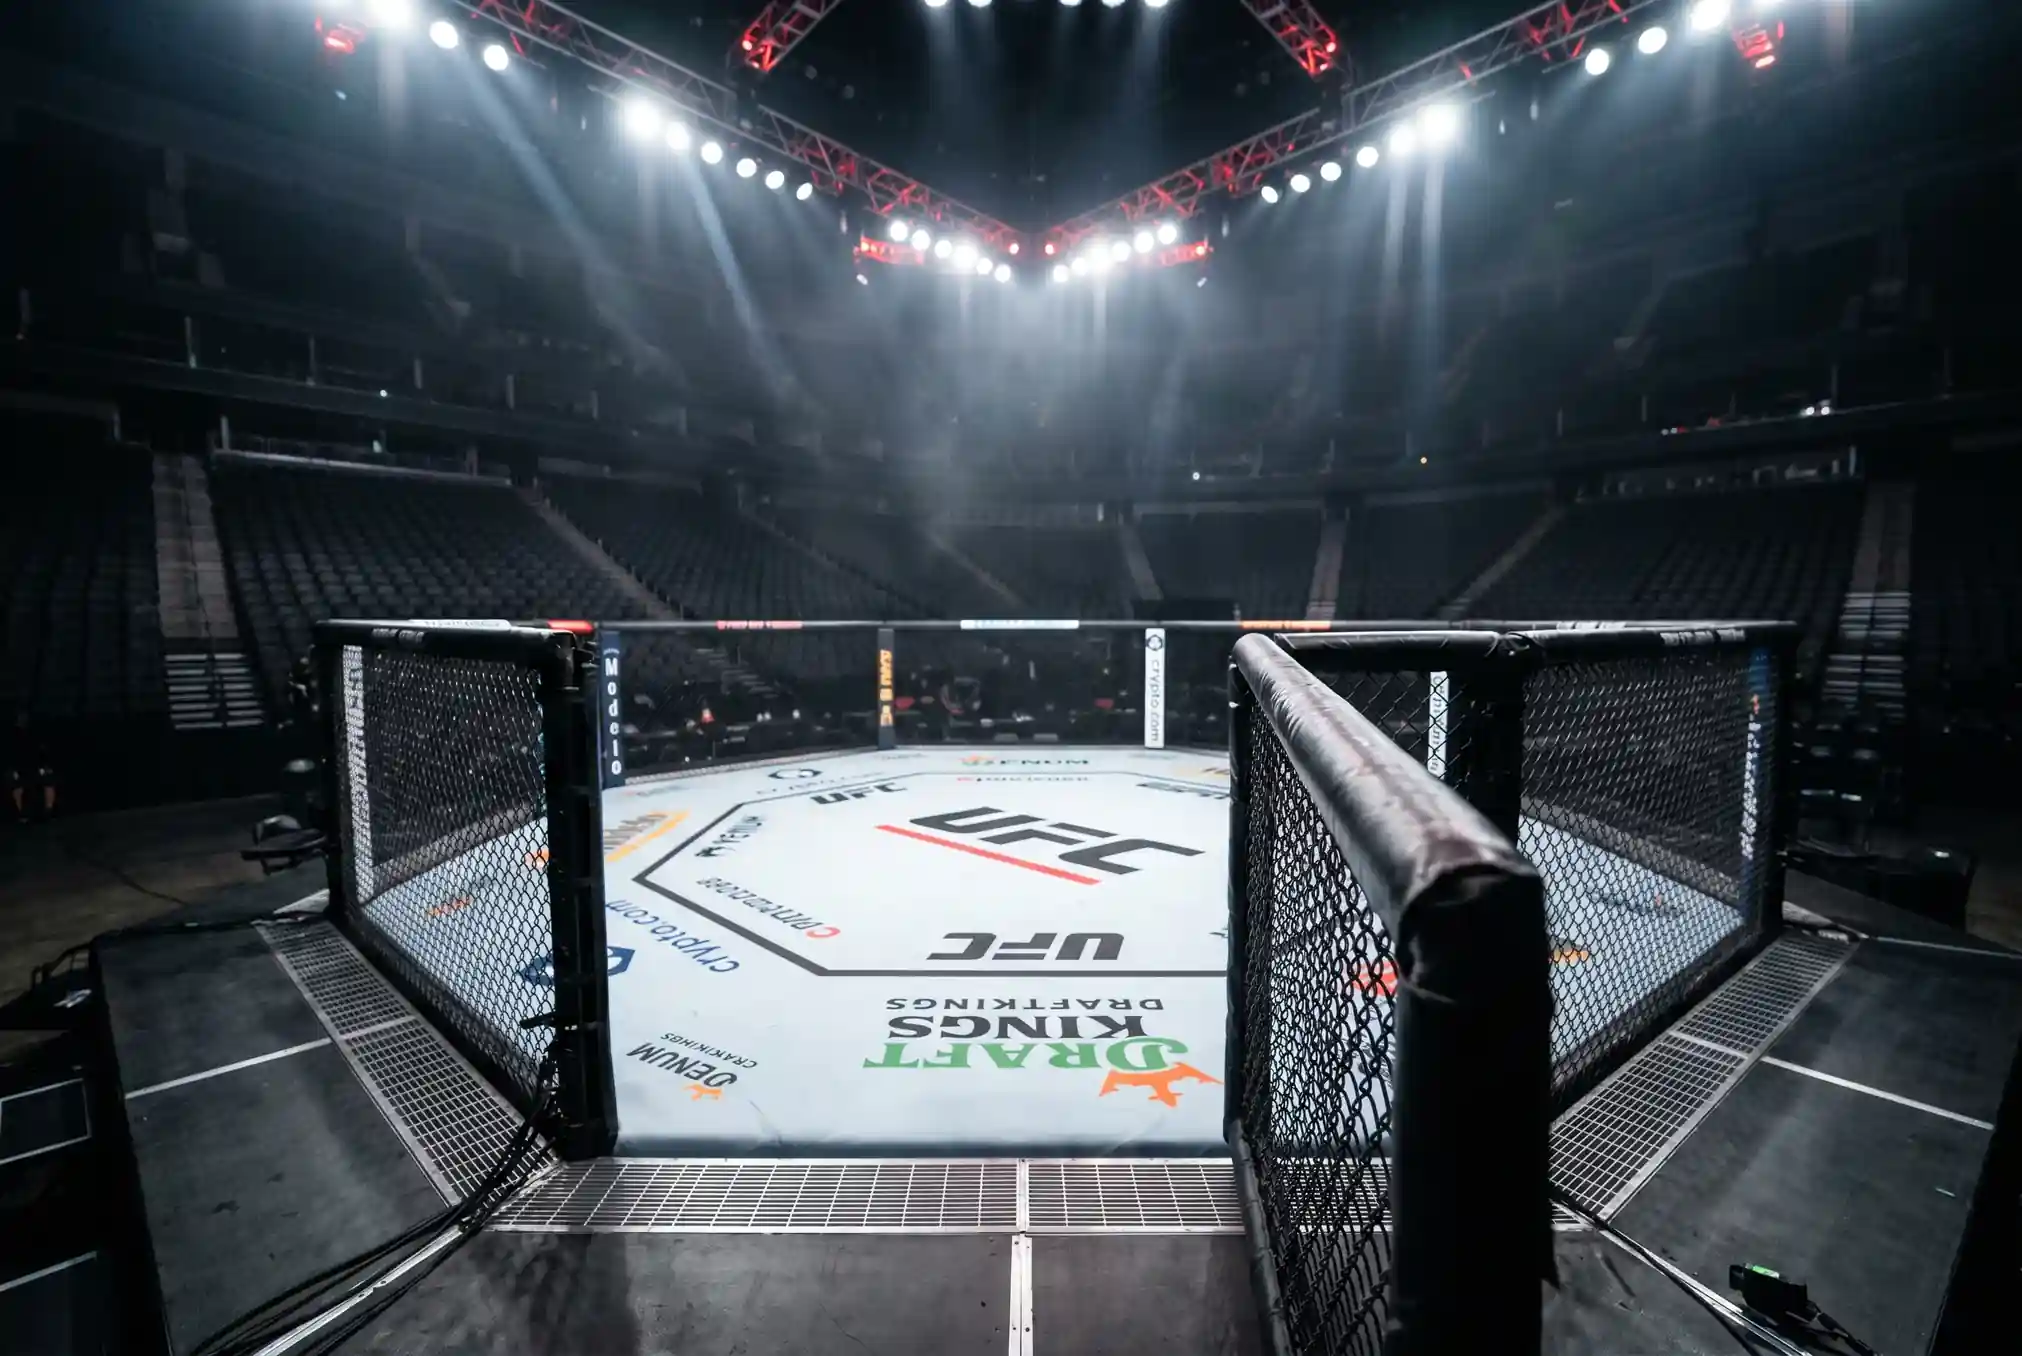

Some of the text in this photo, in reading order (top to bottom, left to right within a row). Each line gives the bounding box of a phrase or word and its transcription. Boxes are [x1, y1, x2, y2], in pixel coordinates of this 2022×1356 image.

[604, 656, 623, 776] Modelo
[810, 782, 909, 805] UFC
[908, 806, 1207, 876] UFC
[605, 899, 741, 974] crypto.com
[926, 932, 1126, 961] UFC
[885, 998, 1164, 1011] DRAFTKINGS
[887, 1015, 1150, 1039] KINGS
[862, 1036, 1191, 1071] DRAFT
